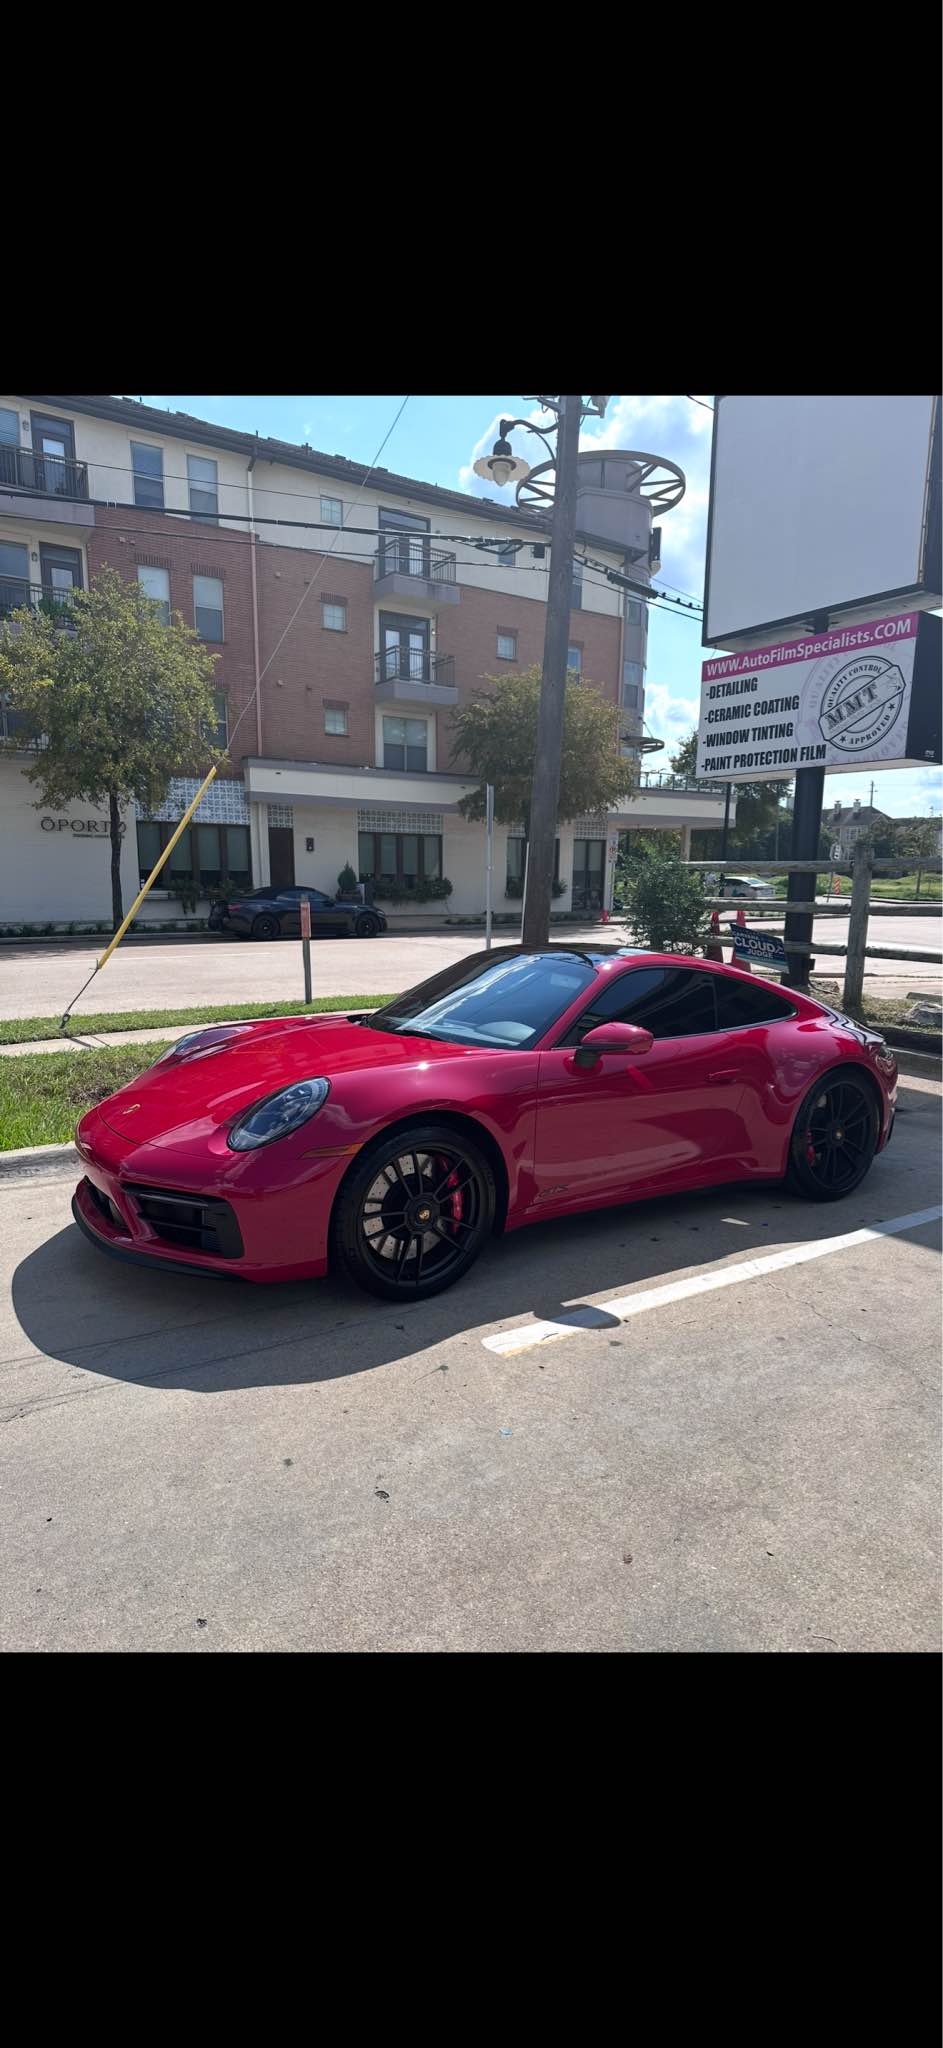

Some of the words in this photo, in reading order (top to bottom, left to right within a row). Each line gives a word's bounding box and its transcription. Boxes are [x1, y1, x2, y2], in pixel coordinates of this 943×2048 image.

[706, 618, 912, 677] WWW.AutoFilmSpecialists.COM
[706, 677, 758, 700] -DETAILING
[827, 674, 848, 708] QUALITY
[848, 664, 882, 677] CONTROL
[704, 703, 751, 724] -CERAMIC
[753, 695, 800, 716] COATING
[824, 682, 878, 730] MMT
[702, 728, 750, 748] -WINDOW
[751, 722, 794, 742] TINTING
[850, 714, 891, 745] APPROVED
[701, 755, 732, 772] -PAINT
[733, 747, 798, 769] PROTECTION
[800, 744, 827, 762] FILM
